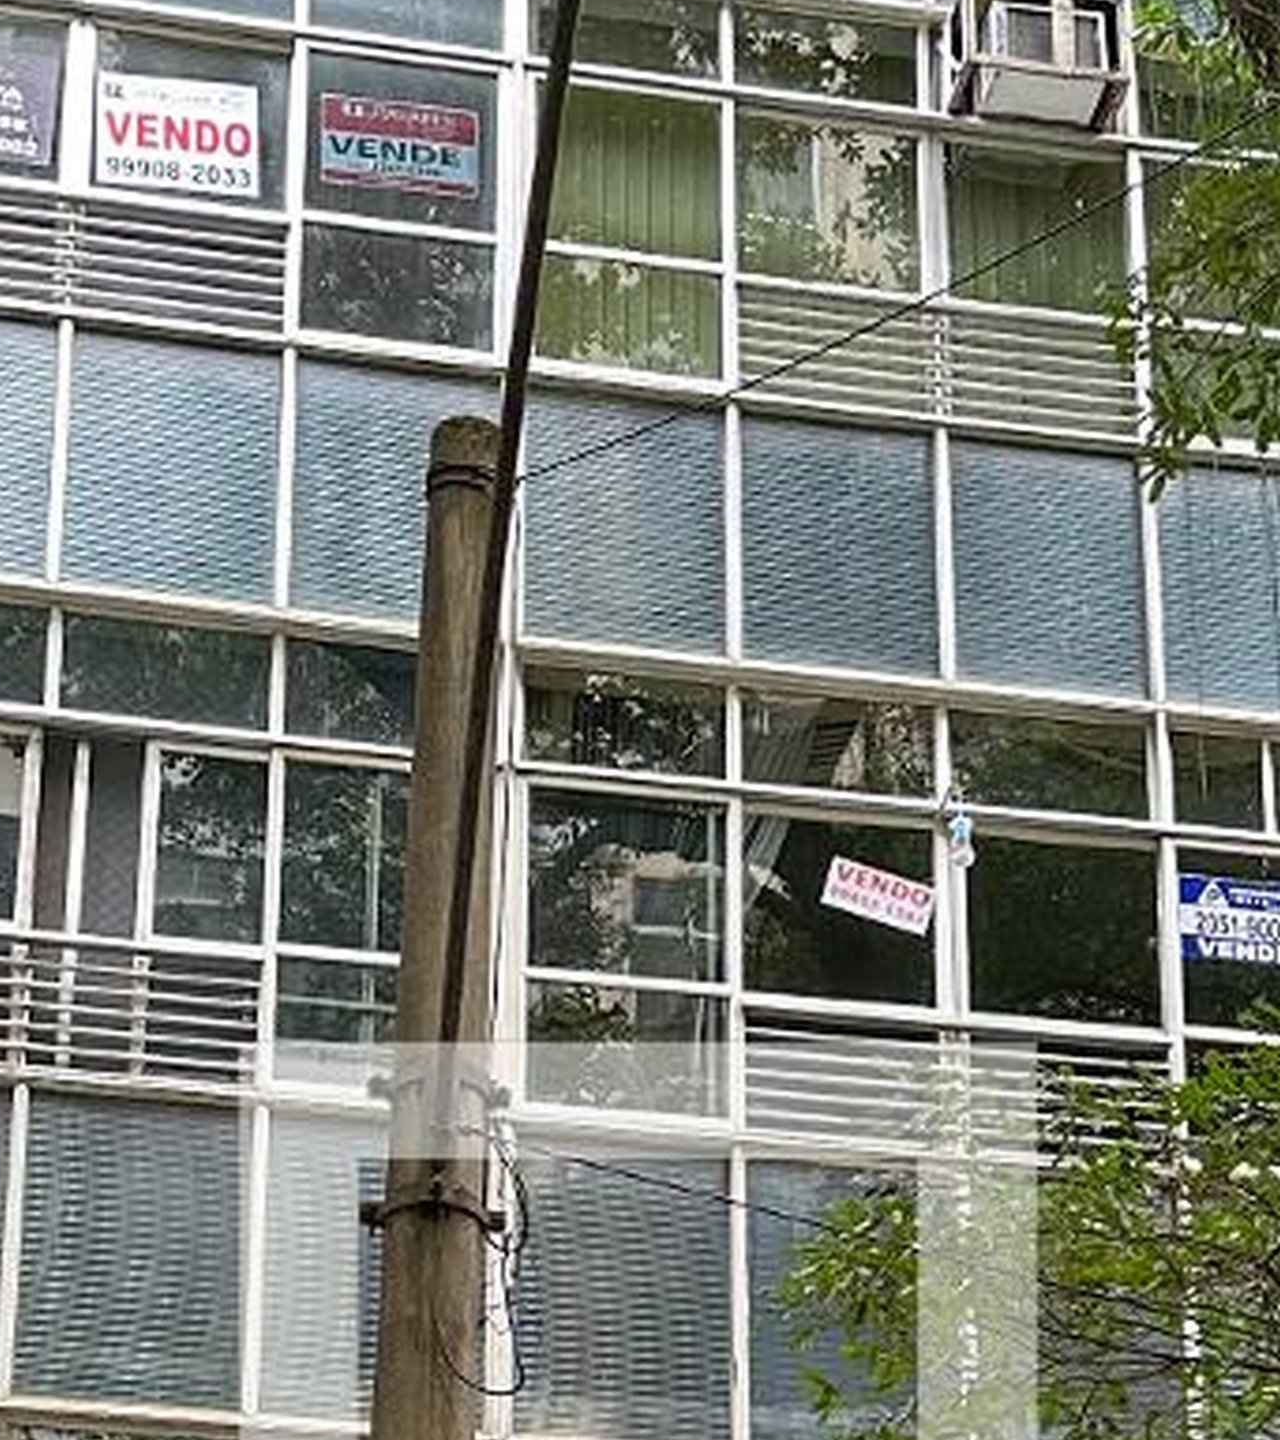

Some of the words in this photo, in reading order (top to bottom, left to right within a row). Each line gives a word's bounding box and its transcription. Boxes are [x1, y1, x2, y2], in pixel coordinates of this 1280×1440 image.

[105, 110, 252, 158] VENDO
[328, 135, 462, 168] VENDE
[105, 156, 252, 188] 99908-2033
[837, 863, 930, 908] VENDO
